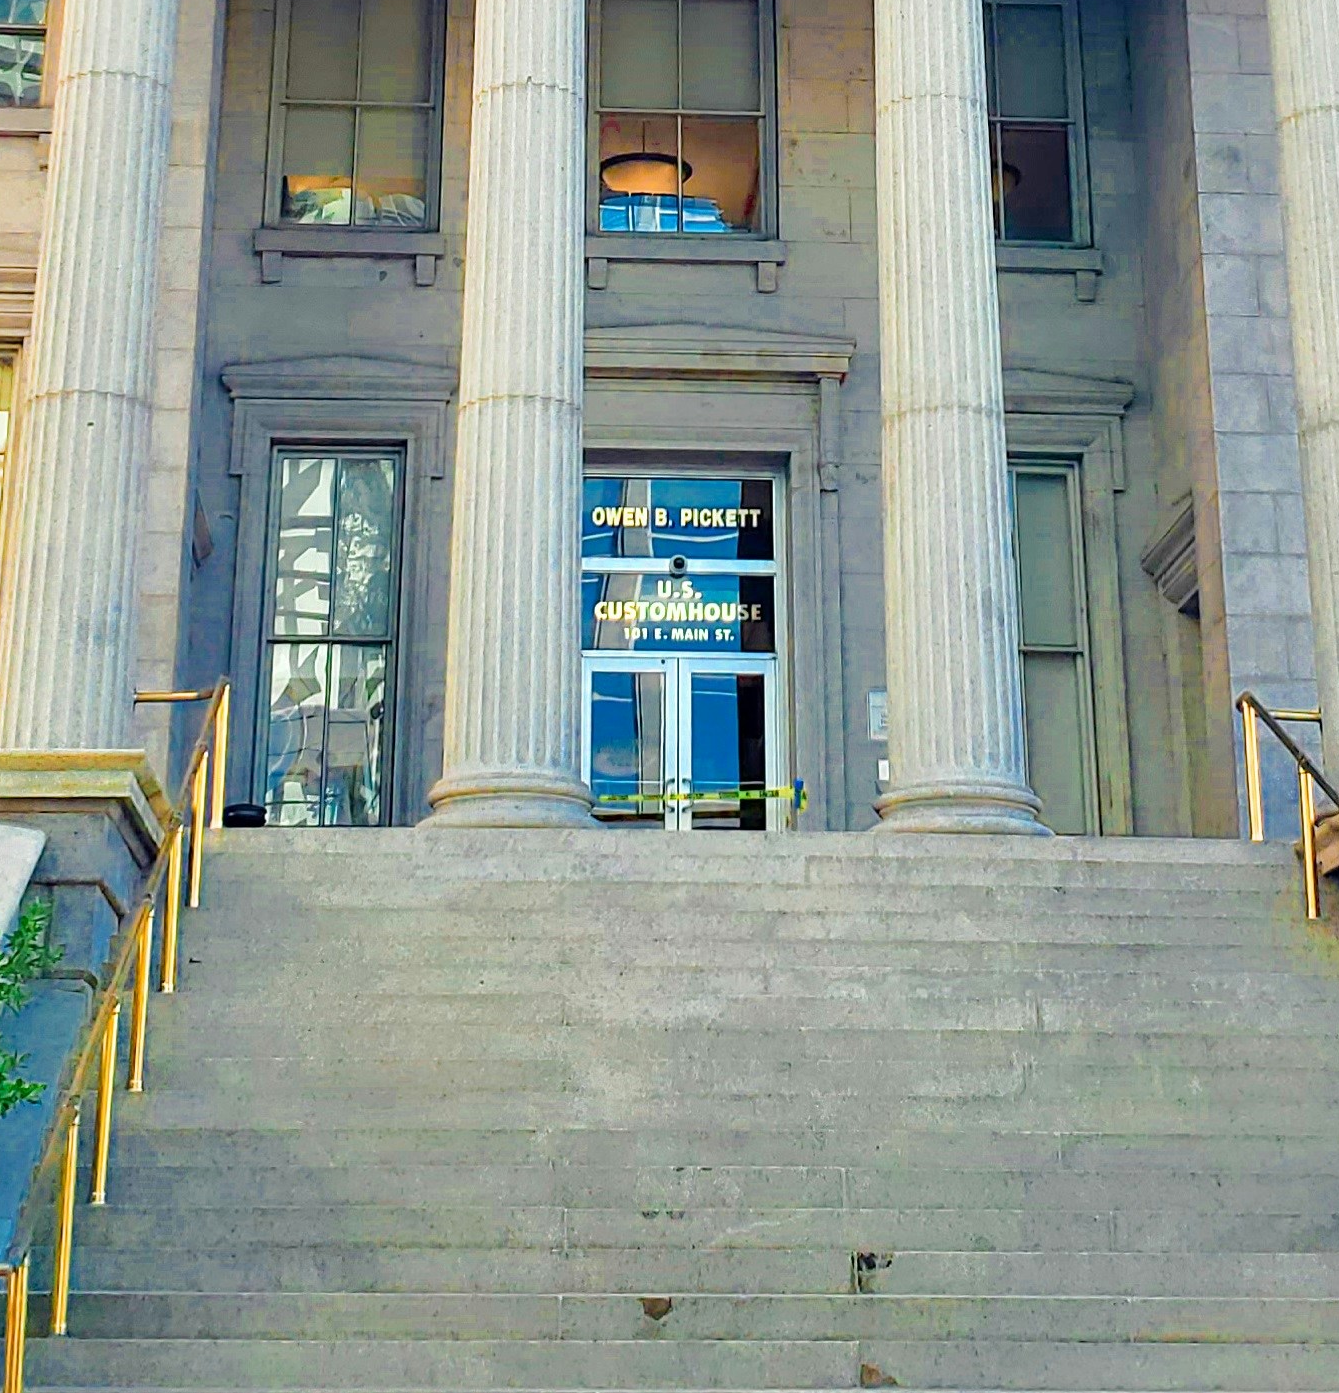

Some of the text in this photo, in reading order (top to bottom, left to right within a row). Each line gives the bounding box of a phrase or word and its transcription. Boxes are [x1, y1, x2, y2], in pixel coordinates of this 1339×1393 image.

[592, 507, 761, 528] OWEN B. PICKETT
[657, 580, 703, 599] U.S.
[594, 601, 762, 622] CUSTOMHOUSE
[624, 627, 735, 641] 101 E. MAIN ST.
